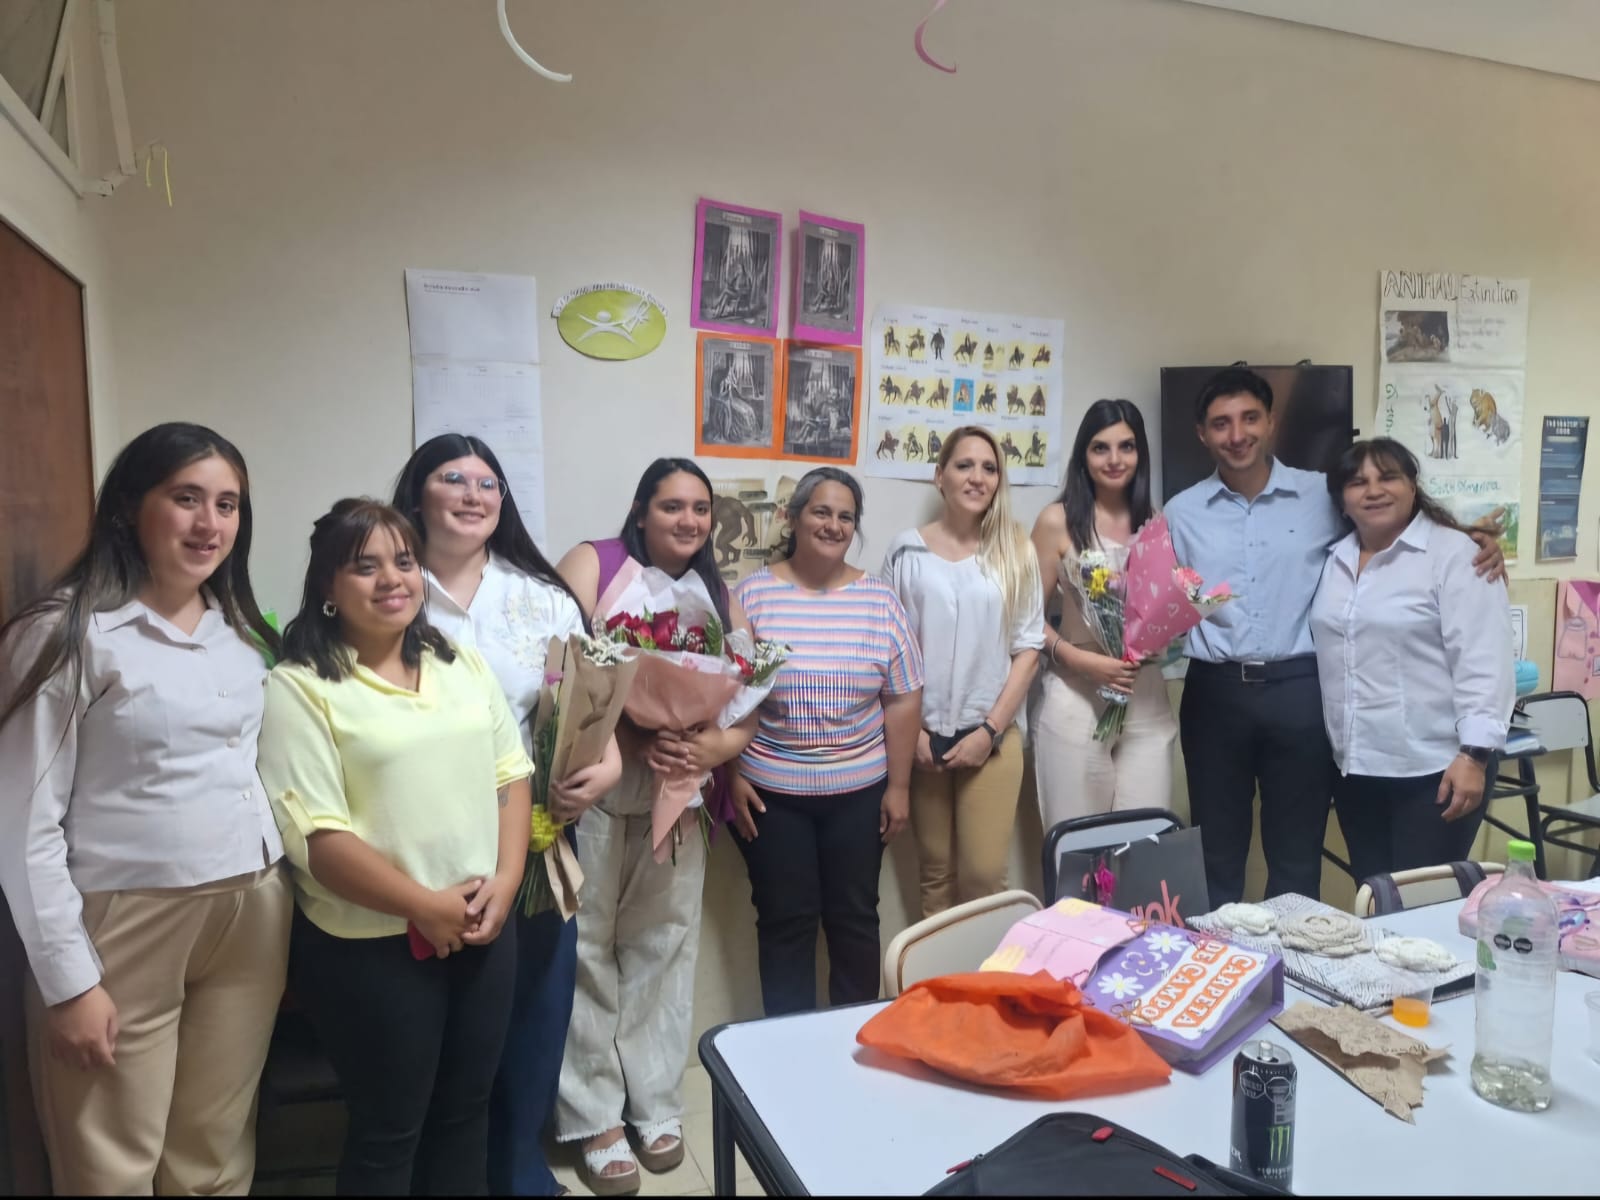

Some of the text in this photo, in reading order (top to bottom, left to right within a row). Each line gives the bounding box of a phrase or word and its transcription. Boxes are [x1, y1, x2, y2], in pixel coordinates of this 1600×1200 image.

[1384, 270, 1459, 301] ANIMAL
[1140, 963, 1206, 1020] CAMPO
[1173, 955, 1255, 1026] CARPETA
